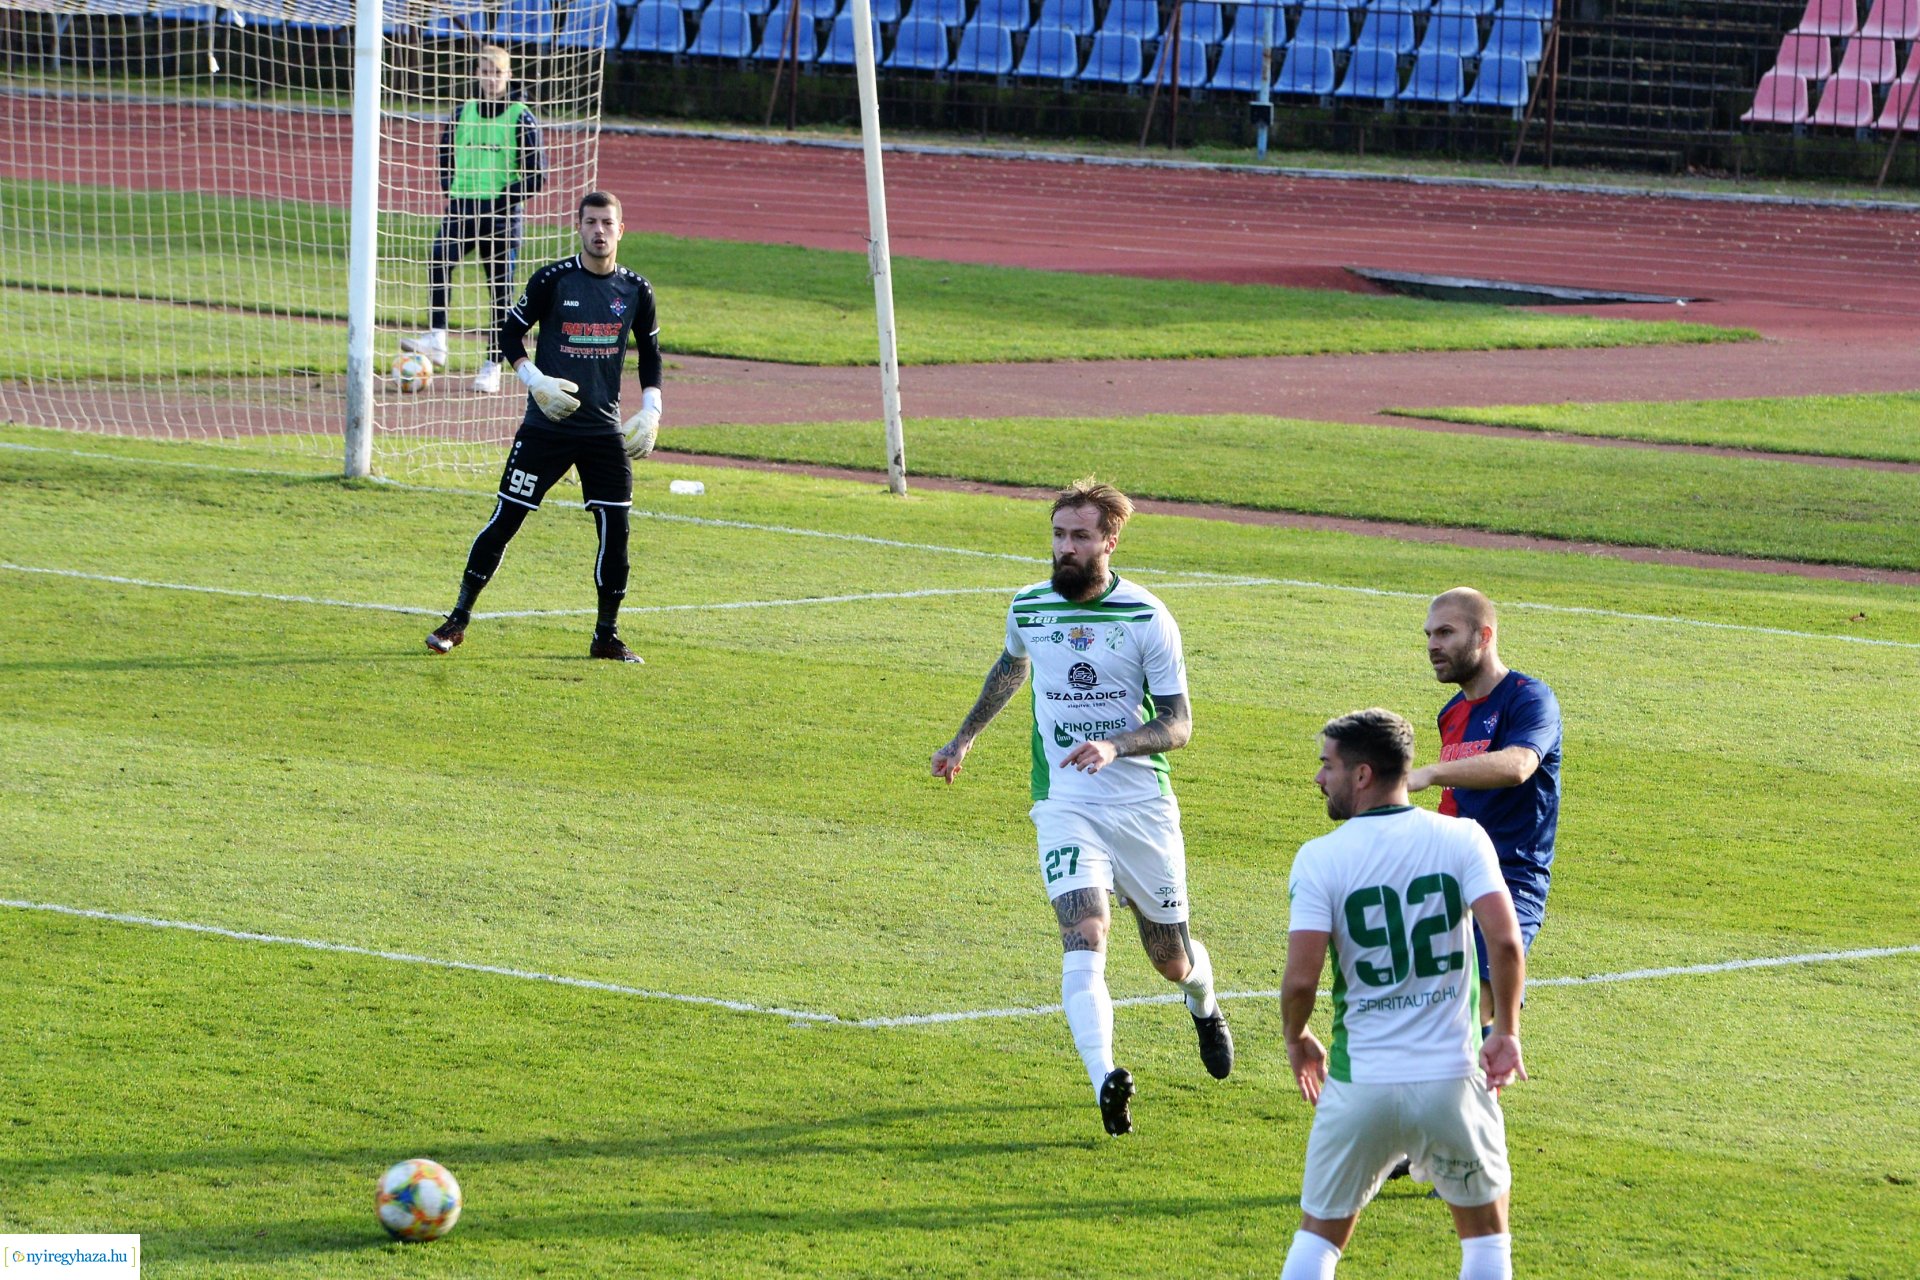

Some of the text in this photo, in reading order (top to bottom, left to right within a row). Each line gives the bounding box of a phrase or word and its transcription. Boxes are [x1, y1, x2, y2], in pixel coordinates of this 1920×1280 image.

[508, 468, 539, 498] 95
[1046, 689, 1127, 701] SZABADICS
[1062, 717, 1127, 732] FINO FRISS
[1045, 846, 1081, 884] 27
[1344, 872, 1465, 987] 92
